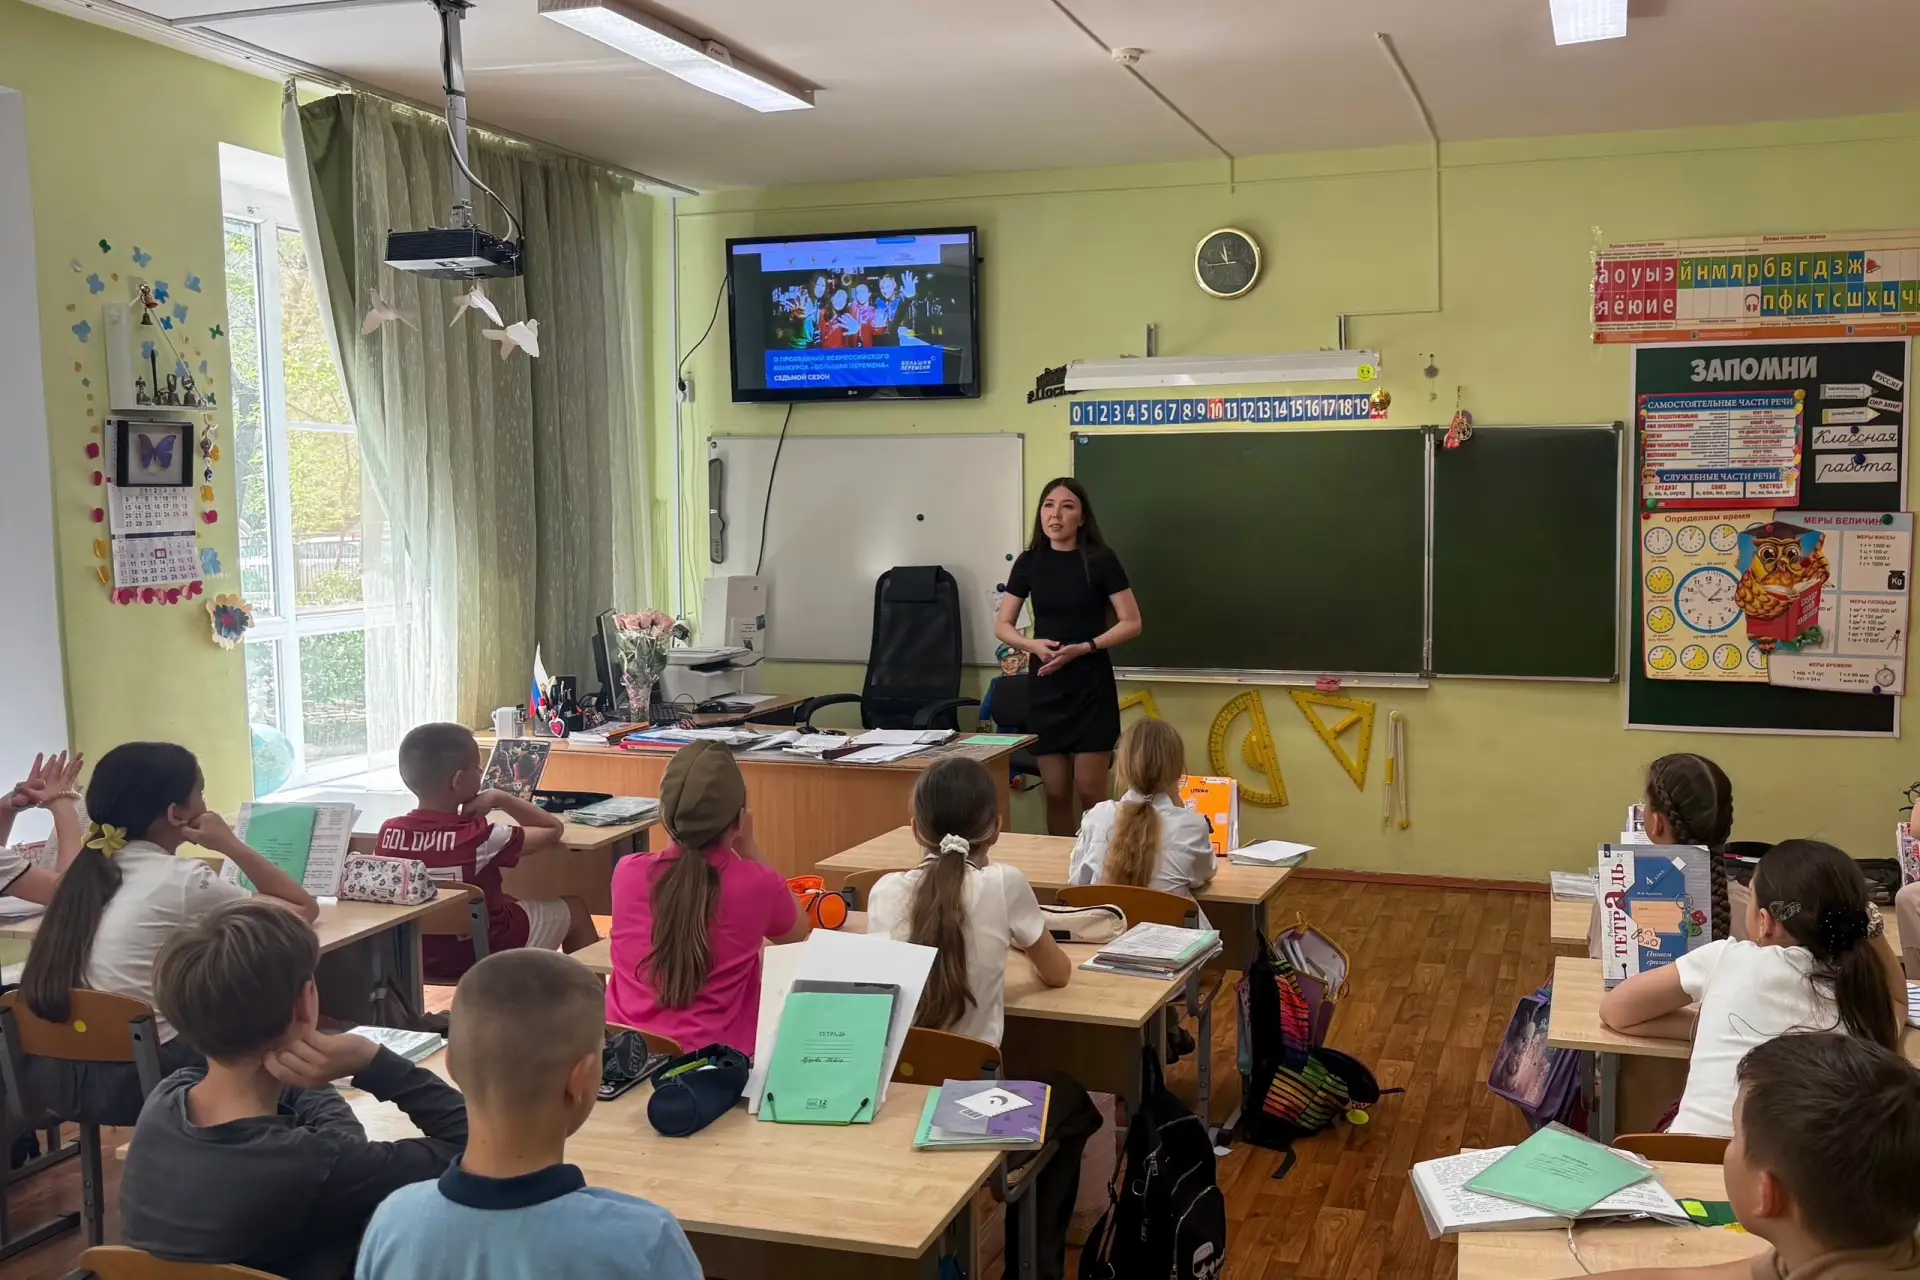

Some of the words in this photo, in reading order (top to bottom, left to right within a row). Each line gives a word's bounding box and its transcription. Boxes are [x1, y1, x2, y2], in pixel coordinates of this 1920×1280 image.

[1599, 269, 1608, 283] а
[1615, 269, 1625, 283] о
[1631, 267, 1641, 288] у
[1646, 268, 1659, 282] ы
[1665, 266, 1674, 281] э
[1681, 261, 1691, 280] й
[1697, 264, 1708, 279] н
[1712, 264, 1726, 279] м
[1731, 264, 1742, 279] л
[1748, 263, 1759, 284] р
[1764, 257, 1775, 278] б
[1781, 262, 1792, 277] в
[1800, 261, 1808, 276] г
[1814, 260, 1827, 279] д
[1833, 260, 1843, 275] з
[1848, 259, 1862, 274] ж
[1597, 300, 1608, 315] я
[1614, 295, 1624, 315] ё
[1629, 299, 1642, 314] ю
[1646, 299, 1657, 313] и
[1663, 298, 1674, 313] е
[1763, 295, 1774, 310] п
[1779, 289, 1792, 314] ф
[1797, 294, 1807, 309] к
[1815, 293, 1825, 308] т
[1833, 292, 1842, 307] с
[1848, 291, 1862, 306] ш
[1867, 291, 1877, 306] х
[1883, 290, 1896, 309] ц
[1903, 290, 1913, 304] ч
[1690, 356, 1817, 382] ЗАПОМНИ
[773, 373, 807, 382] СЕДЬМОЙ
[1648, 400, 1738, 409] САМОСТОЯТЕЛЬНЫЕ
[1771, 398, 1793, 406] РЕЧИ
[1073, 406, 1081, 422] 0
[1087, 406, 1093, 421] 1
[1100, 405, 1107, 422] 2
[1114, 405, 1121, 421] 3
[1127, 405, 1135, 421] 4
[1141, 404, 1148, 420] 5
[1155, 404, 1163, 420] 6
[1169, 404, 1176, 420] 7
[1183, 403, 1191, 420] 8
[1197, 403, 1205, 419] 9
[1210, 402, 1223, 419] 10
[1225, 403, 1237, 420] 11
[1242, 402, 1254, 419] 12
[1258, 401, 1270, 418] 13
[1274, 401, 1287, 418] 14
[1290, 400, 1302, 417] 15
[1306, 399, 1319, 417] 16
[1322, 399, 1335, 416] 17
[1338, 399, 1352, 416] 18
[1354, 398, 1368, 415] 19
[1814, 430, 1897, 444] Классная
[1663, 473, 1718, 481] СЛУЖЕБНЫЕ
[1753, 472, 1776, 480] РЕЧИ
[1665, 515, 1720, 523] Определяем
[1836, 517, 1882, 525] ВЕЛИЧИН
[1892, 577, 1902, 586] Kg
[381, 827, 456, 852] GOLOVIN
[1646, 876, 1654, 885] 4
[1605, 863, 1628, 958] ТЕТРАДЬ
